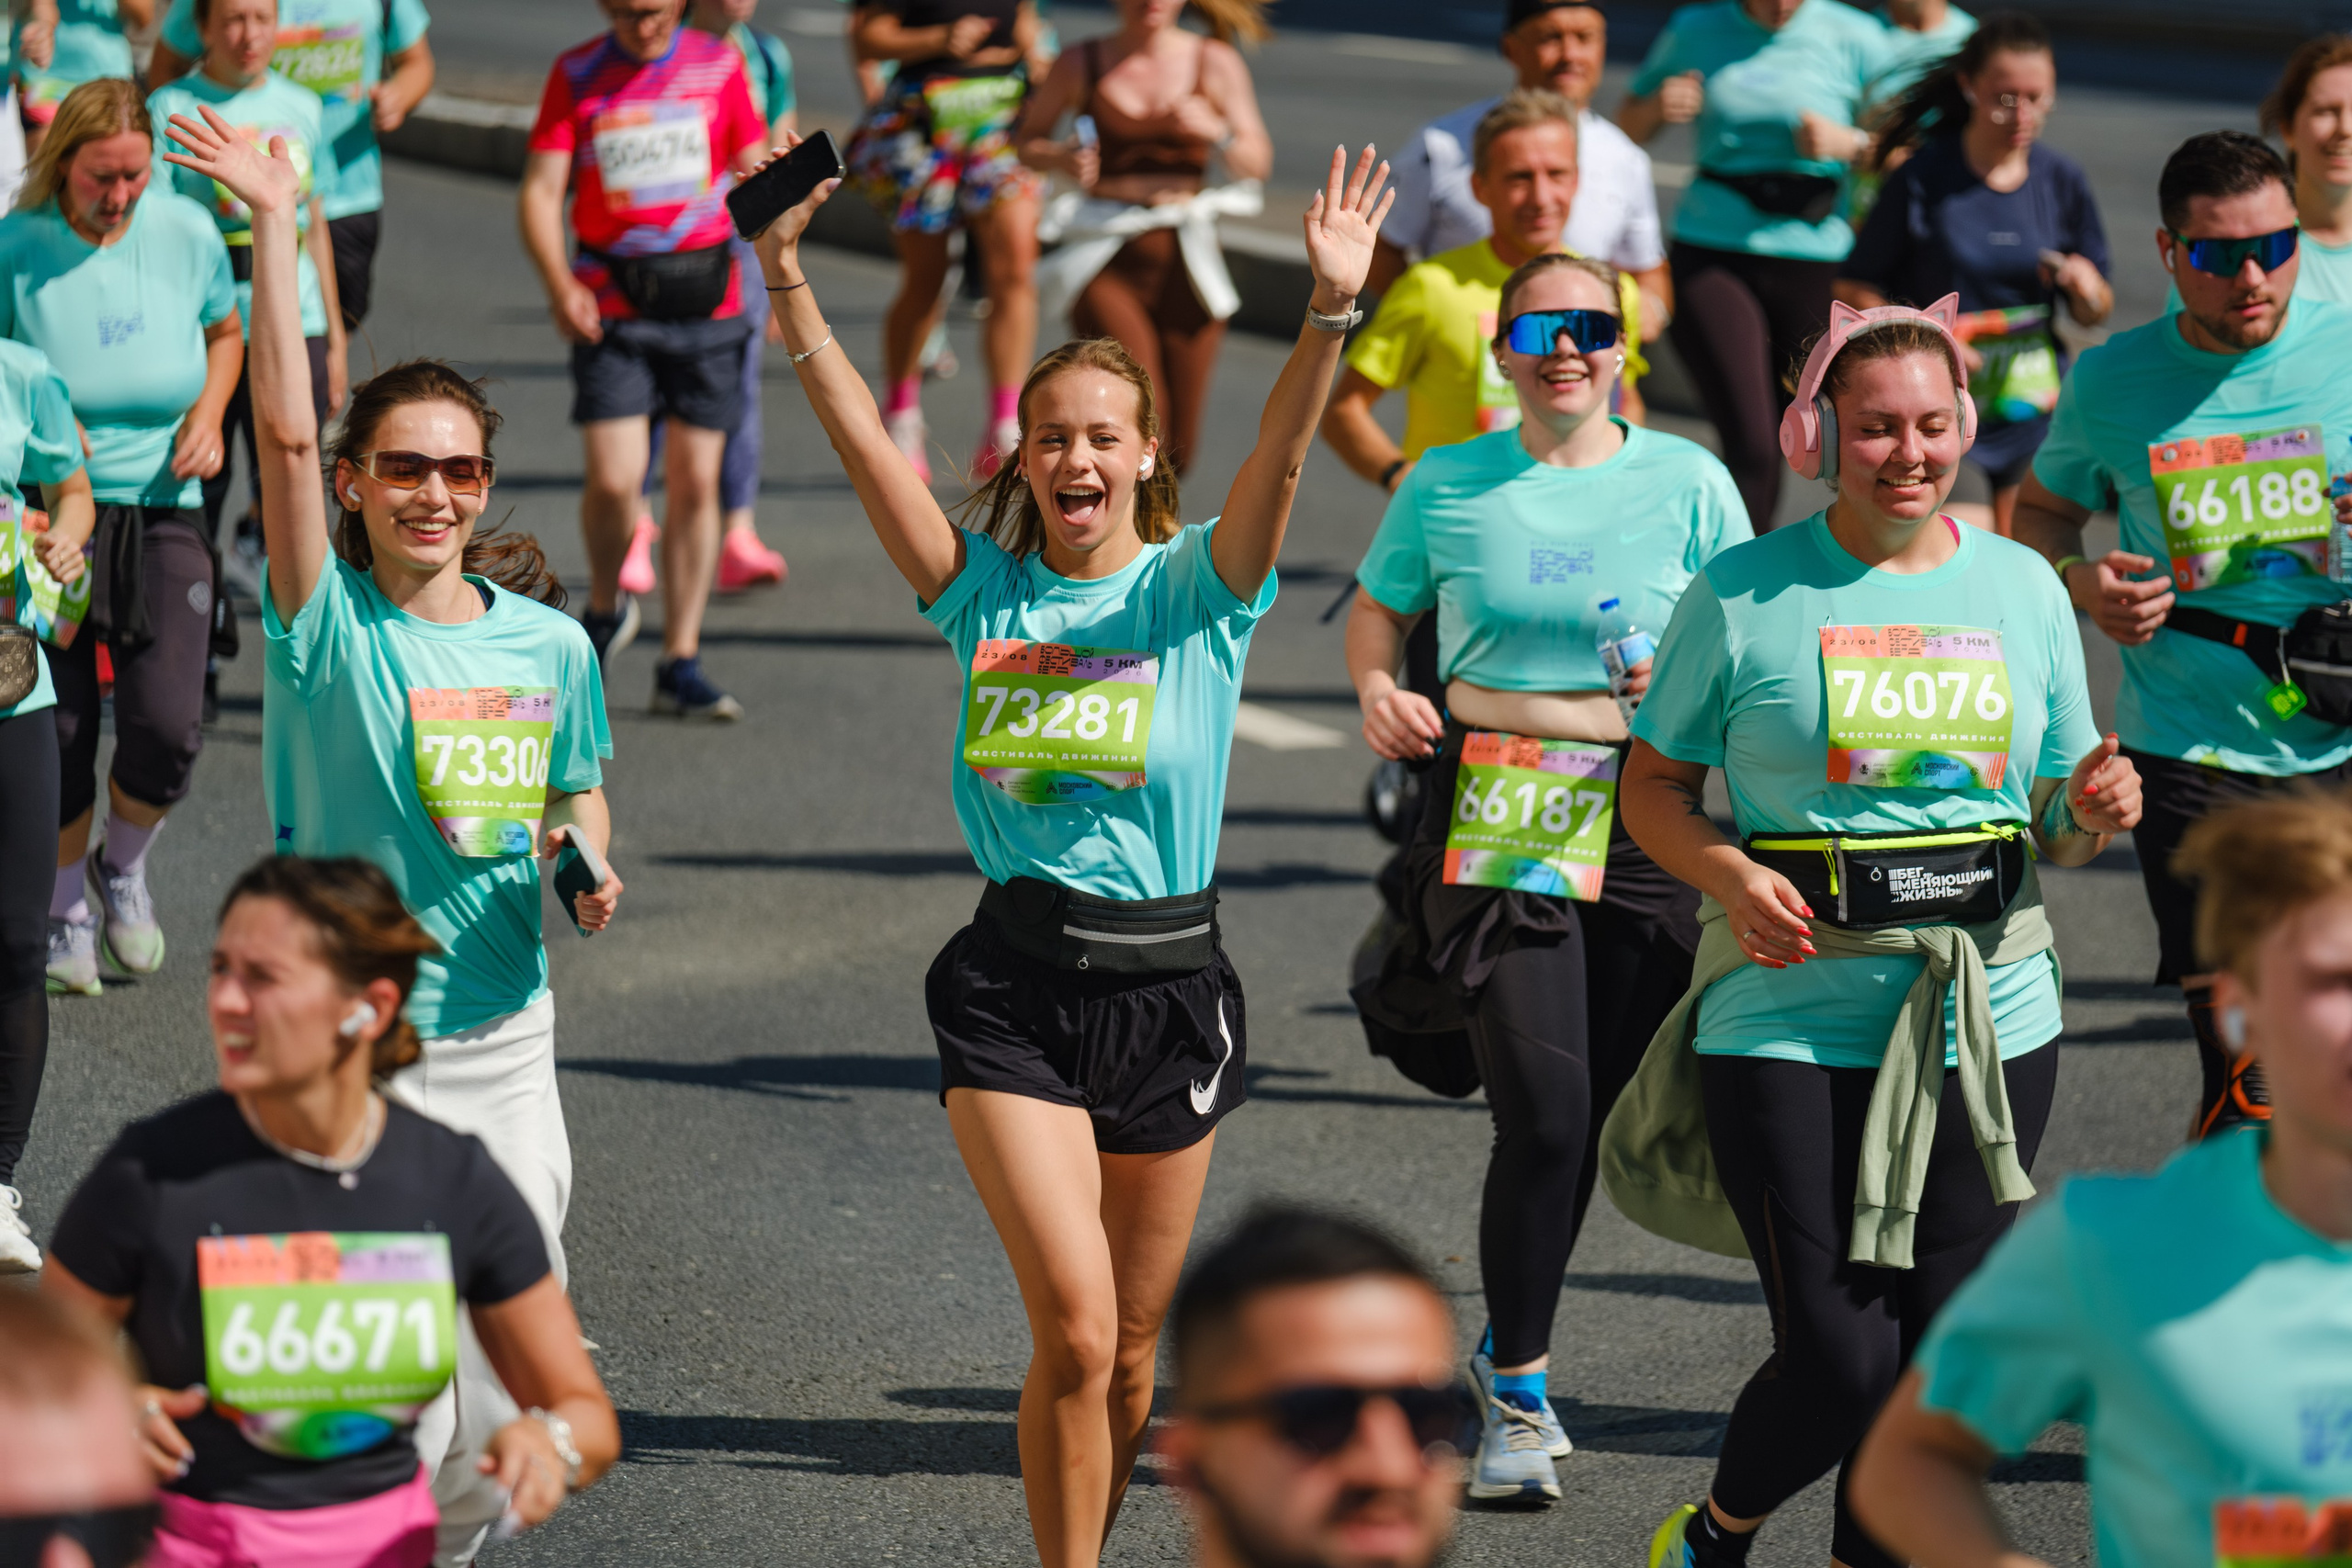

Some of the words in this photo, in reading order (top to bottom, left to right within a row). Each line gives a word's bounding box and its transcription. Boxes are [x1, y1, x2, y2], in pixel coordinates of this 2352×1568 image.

[2167, 468, 2323, 530] 66188
[1952, 637, 1962, 645] 5
[1953, 646, 1991, 654] 2026
[981, 652, 1027, 661] 23/08
[1104, 659, 1114, 668] 5
[1103, 669, 1142, 677] 2026
[1833, 670, 2007, 721] 76076
[420, 699, 466, 707] 23/08
[534, 698, 540, 706] 5
[976, 686, 1139, 743] 73281
[1838, 731, 1922, 740] ФЕСТИВАЛЬ
[1929, 733, 2006, 742] ДВИЖЕНИЯ
[422, 735, 549, 788] 73306
[972, 750, 1054, 760] ФЕСТИВАЛЬ
[1061, 752, 1138, 763] ДВИЖЕНИЯ
[1924, 762, 1960, 772] МОСКОВСКИЙ
[1924, 769, 1941, 777] СПОРТ
[1458, 776, 1607, 838] 66187
[1898, 866, 1991, 892] МЕНЯЮЩИЙ
[220, 1297, 439, 1376] 66671
